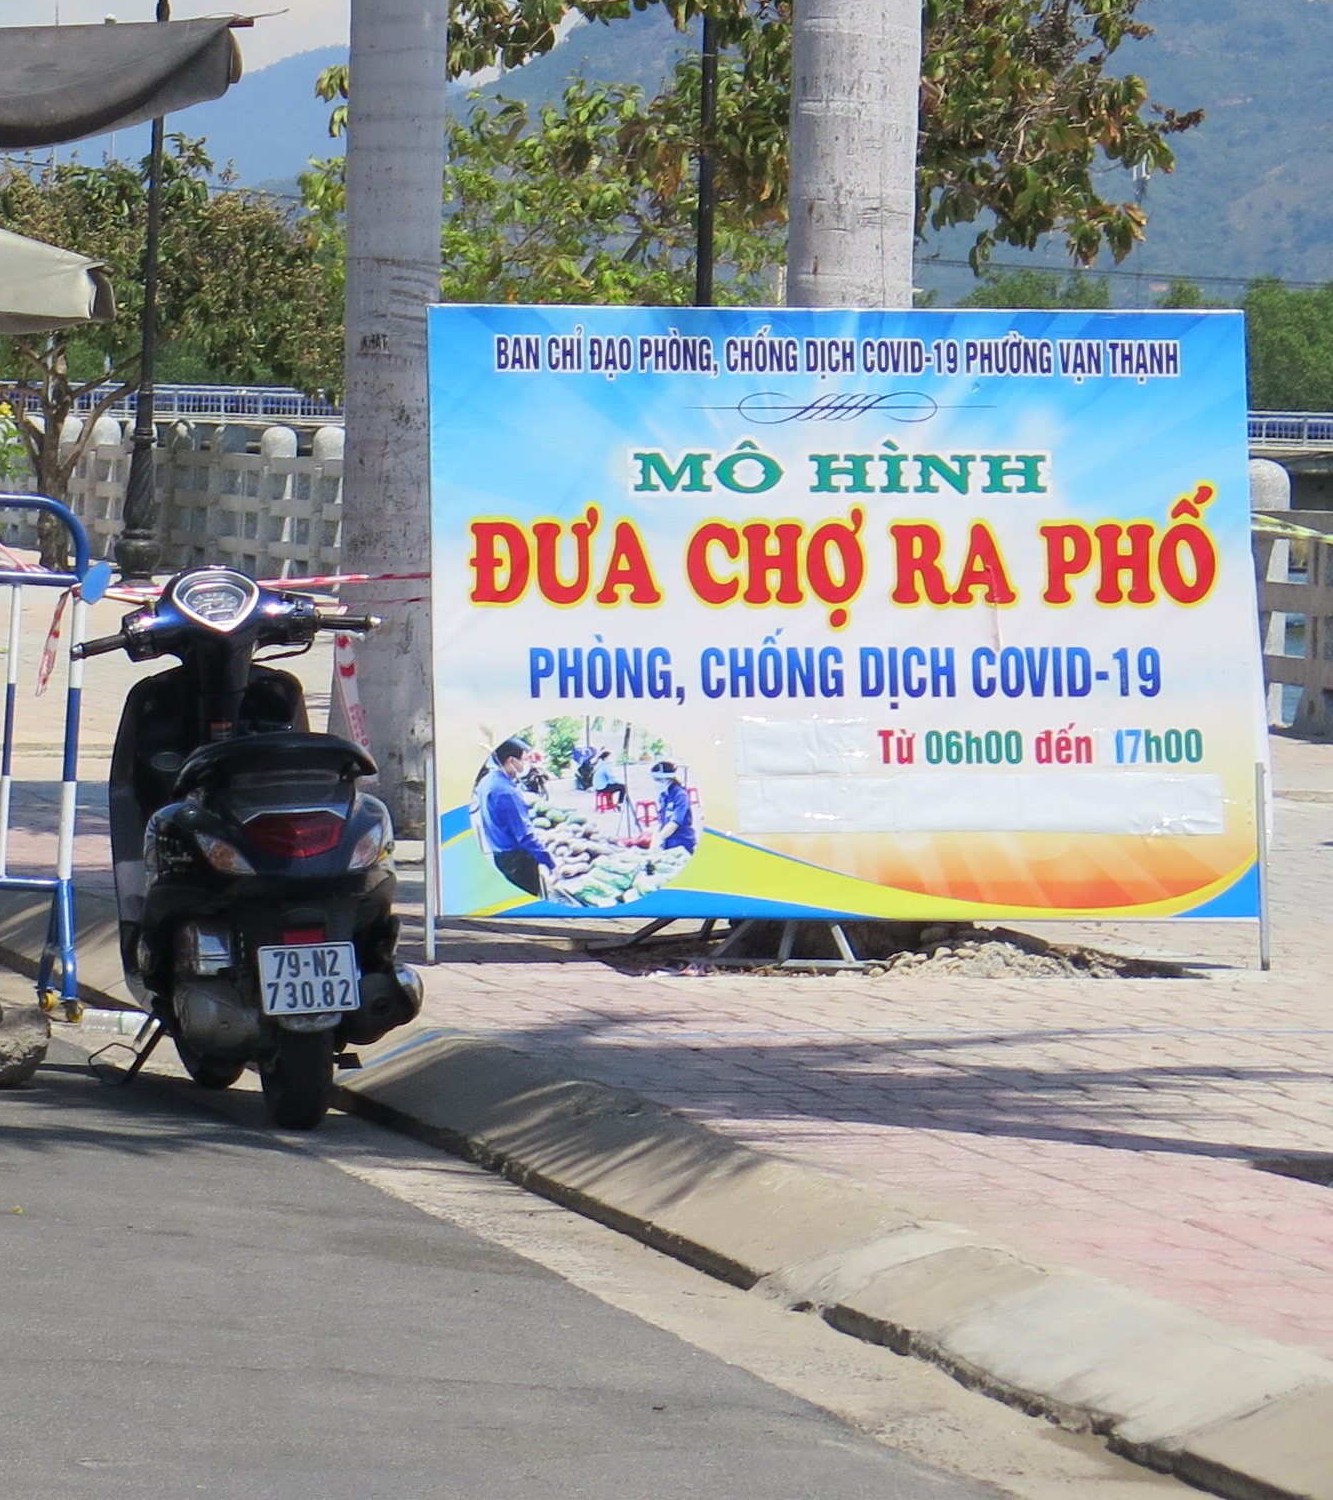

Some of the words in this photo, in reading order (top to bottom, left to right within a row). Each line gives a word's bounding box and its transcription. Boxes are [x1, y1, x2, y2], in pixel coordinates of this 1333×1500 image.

[495, 335, 540, 373] BAN
[547, 325, 584, 374] CHỈ
[589, 336, 633, 379] ĐẠO
[639, 328, 719, 378] PHÒNG,
[725, 325, 799, 374] CHỐNG
[806, 338, 856, 380] DỊCH
[862, 338, 957, 374] COVID-19
[966, 332, 1053, 376] PHƯỜNG
[1059, 340, 1104, 382] VẠN
[1109, 340, 1179, 381] THẠNH
[633, 440, 783, 493] MÔ
[808, 439, 1047, 494] HÌNH
[469, 508, 661, 604] ĐƯA
[686, 508, 864, 627] CHỢ
[891, 520, 1017, 604] RA
[1040, 482, 1216, 604] PHỐ
[530, 634, 686, 704] PHÒNG,
[700, 627, 843, 699] CHỐNG
[861, 648, 957, 709] DỊCH
[970, 648, 1162, 700] COVID-19
[877, 727, 915, 764] Từ
[925, 728, 1023, 765] 06h00
[1034, 726, 1093, 765] đến
[1114, 728, 1203, 765] 17h00
[273, 949, 341, 980] 79-N2
[266, 979, 353, 1011] 730.82
